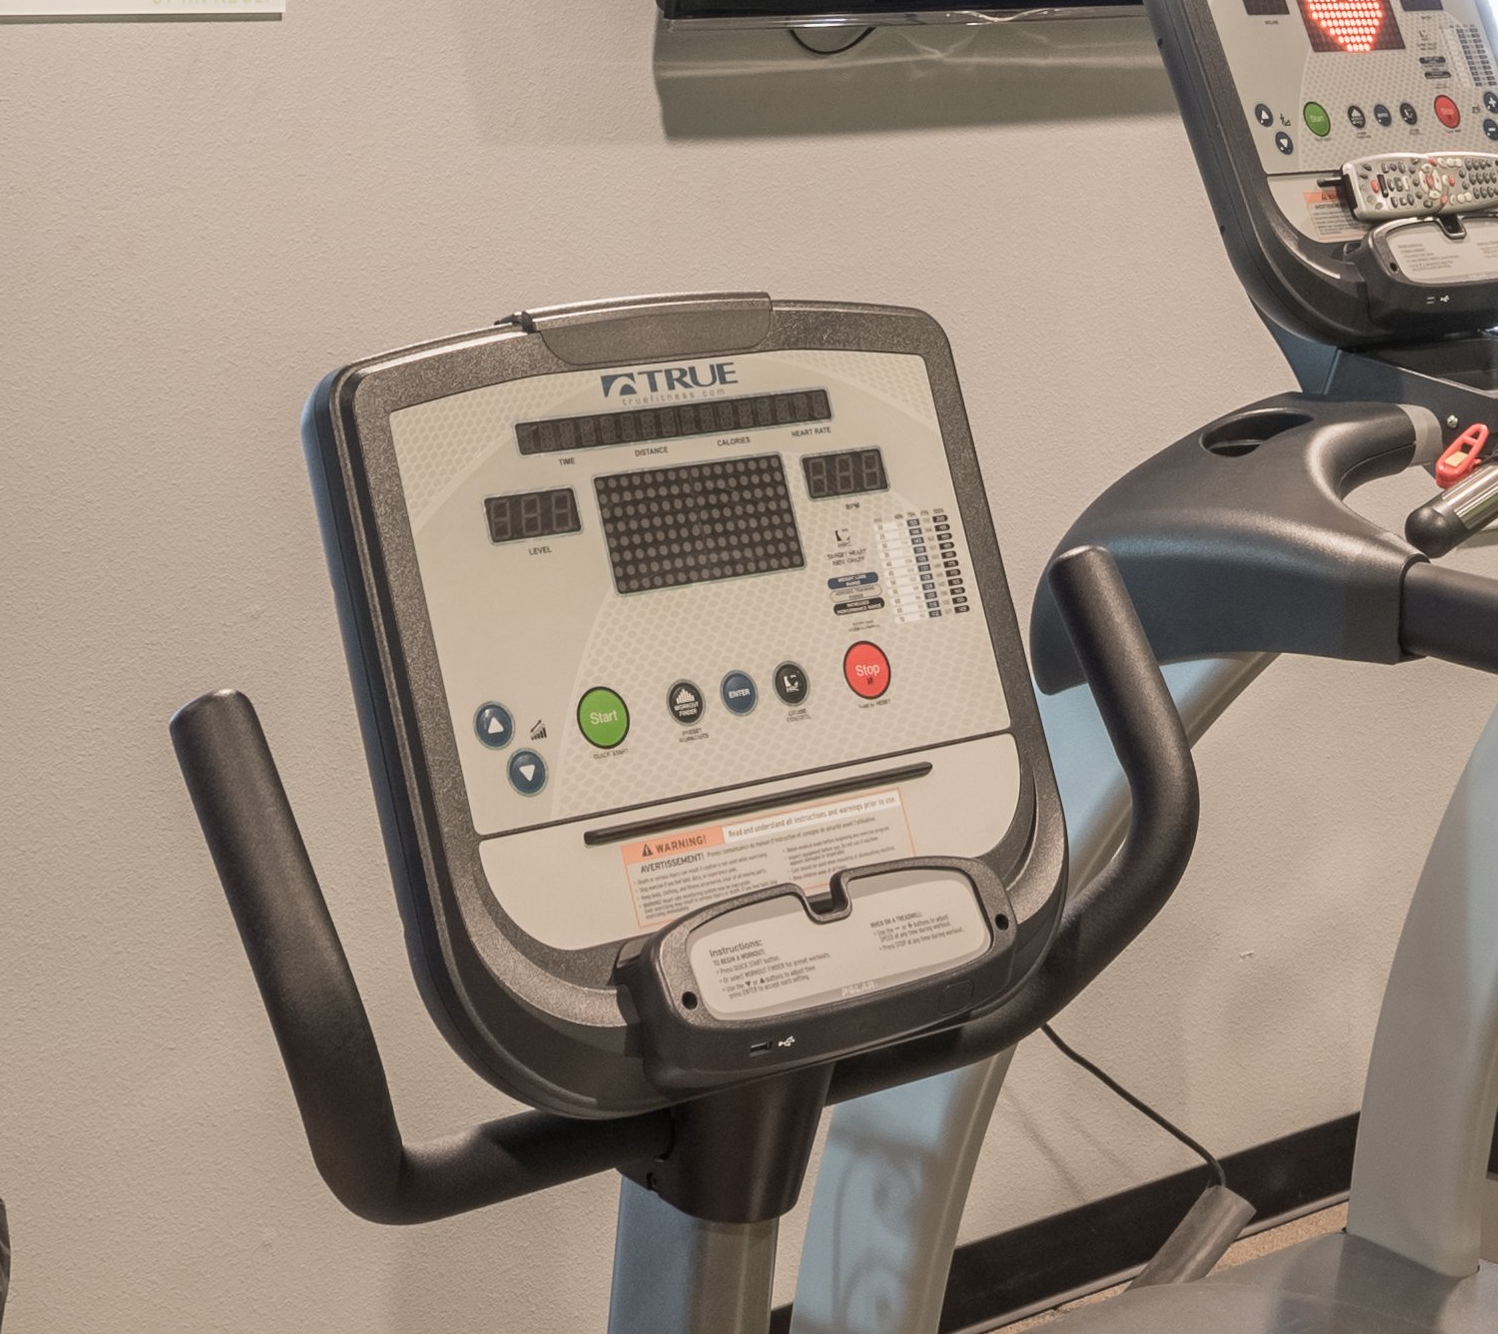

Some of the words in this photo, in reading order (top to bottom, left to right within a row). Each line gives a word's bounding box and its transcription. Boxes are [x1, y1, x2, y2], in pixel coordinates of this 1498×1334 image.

[637, 362, 739, 393] TRUE
[791, 428, 813, 438] HEART
[815, 426, 831, 436] RATE
[717, 436, 751, 447] CALORIES
[635, 446, 669, 457] DISTANCE
[559, 457, 576, 466] TIME
[528, 546, 552, 556] LEVEL
[855, 664, 880, 677] Stop
[728, 688, 751, 699] ENTER
[590, 710, 619, 725] Start
[728, 828, 743, 838] Read
[743, 826, 754, 835] and
[655, 835, 707, 855] WARNING!
[641, 853, 705, 874] AVERTISSEMENT!
[709, 938, 763, 958] Instructions:
[841, 982, 875, 997] POLAR
